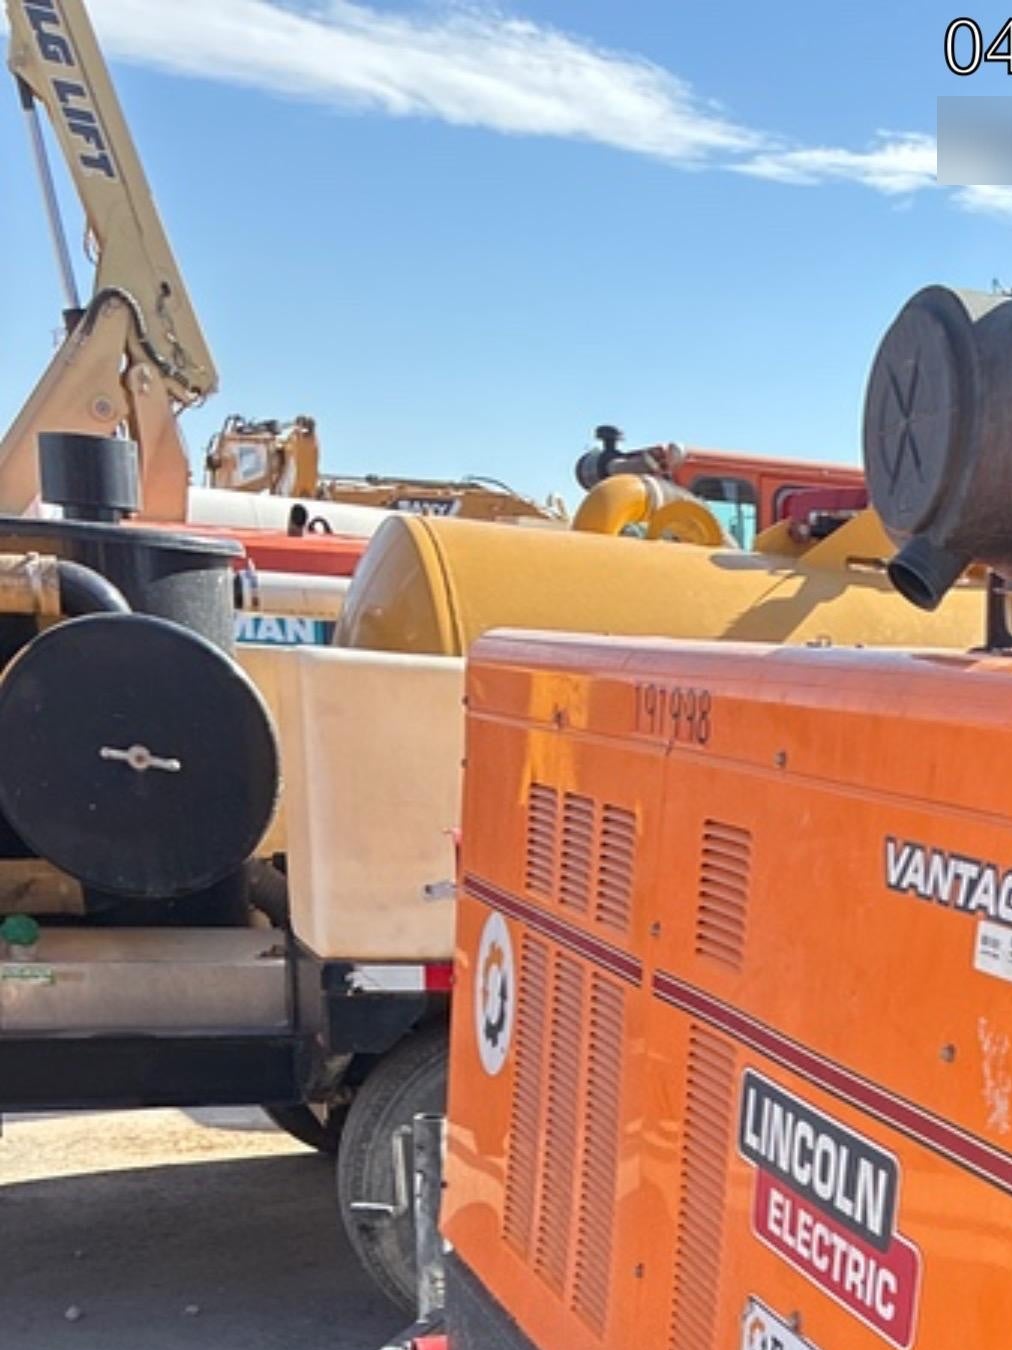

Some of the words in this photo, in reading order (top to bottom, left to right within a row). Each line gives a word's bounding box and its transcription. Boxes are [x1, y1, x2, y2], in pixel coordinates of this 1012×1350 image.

[53, 80, 116, 178] LIFT
[743, 1087, 889, 1238] LINCOLN
[766, 1187, 899, 1322] ELECTRIC
